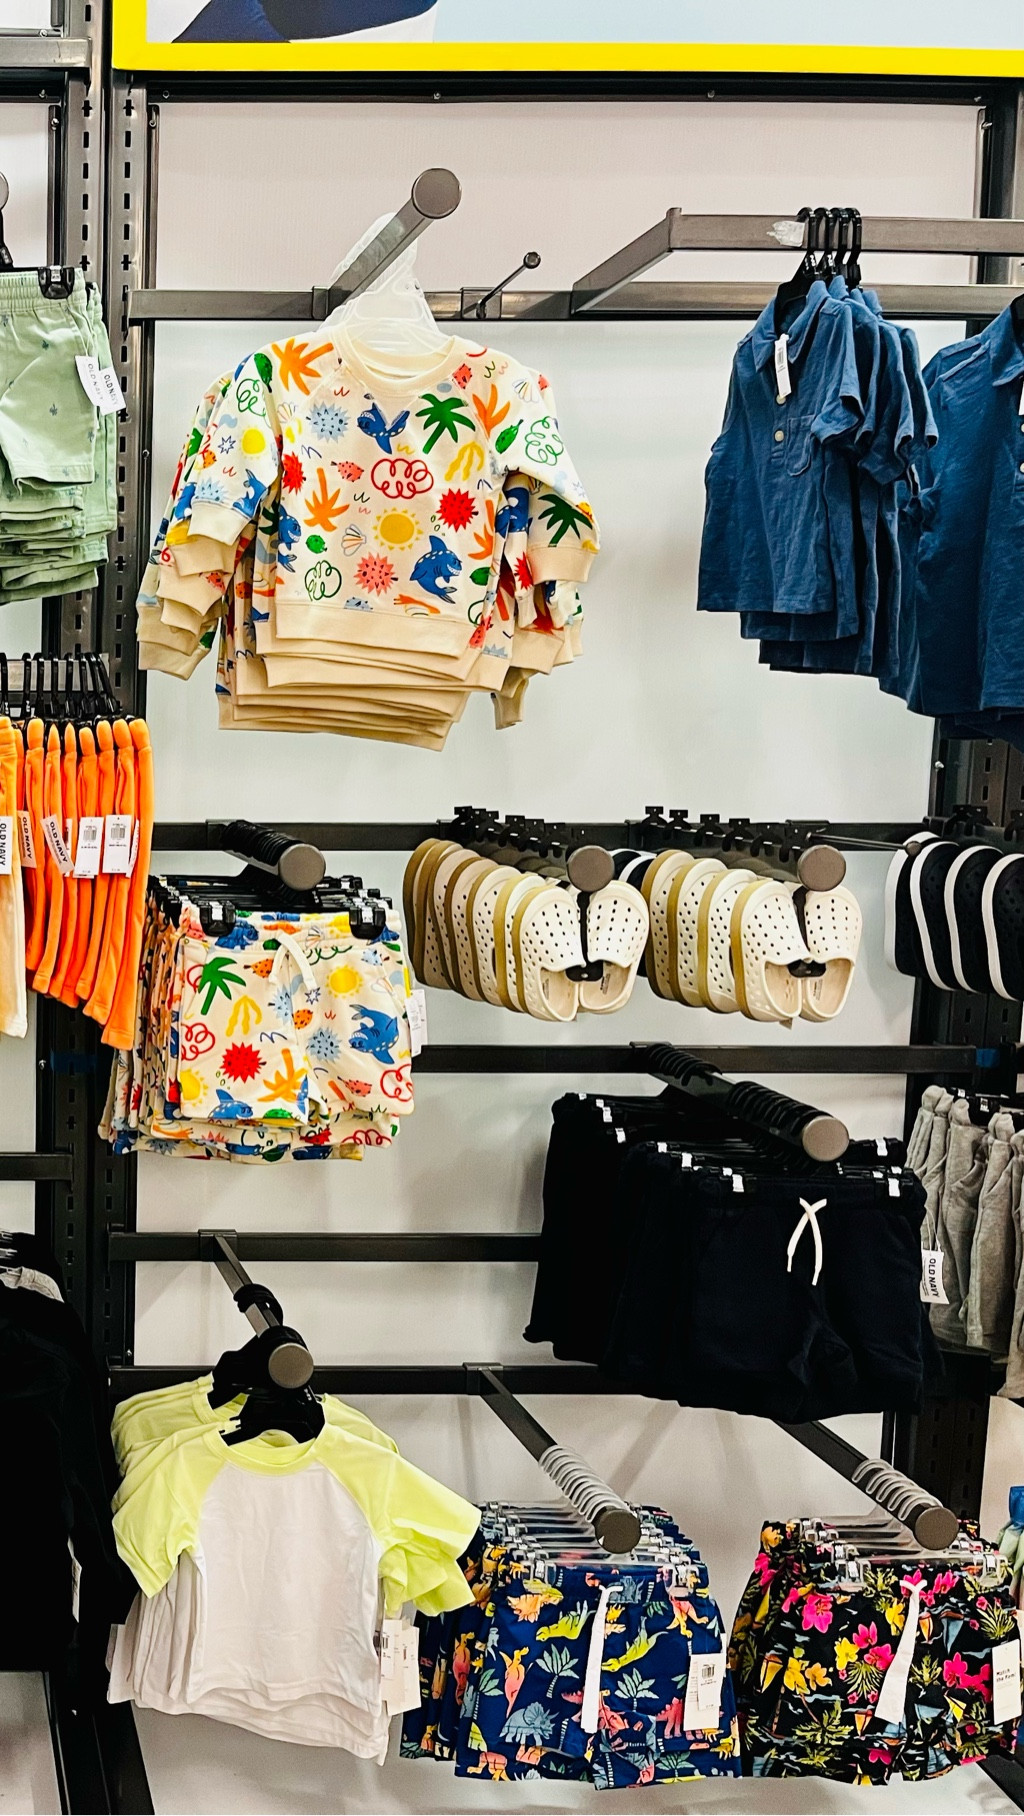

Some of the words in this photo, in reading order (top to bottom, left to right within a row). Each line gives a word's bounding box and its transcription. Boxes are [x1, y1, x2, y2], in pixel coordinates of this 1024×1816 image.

[104, 374, 113, 388] OLD
[0, 823, 7, 840] OLD
[50, 821, 58, 839] OLD
[55, 839, 68, 863] NAVY
[928, 1258, 936, 1275] OLD
[928, 1277, 939, 1297] NAVY
